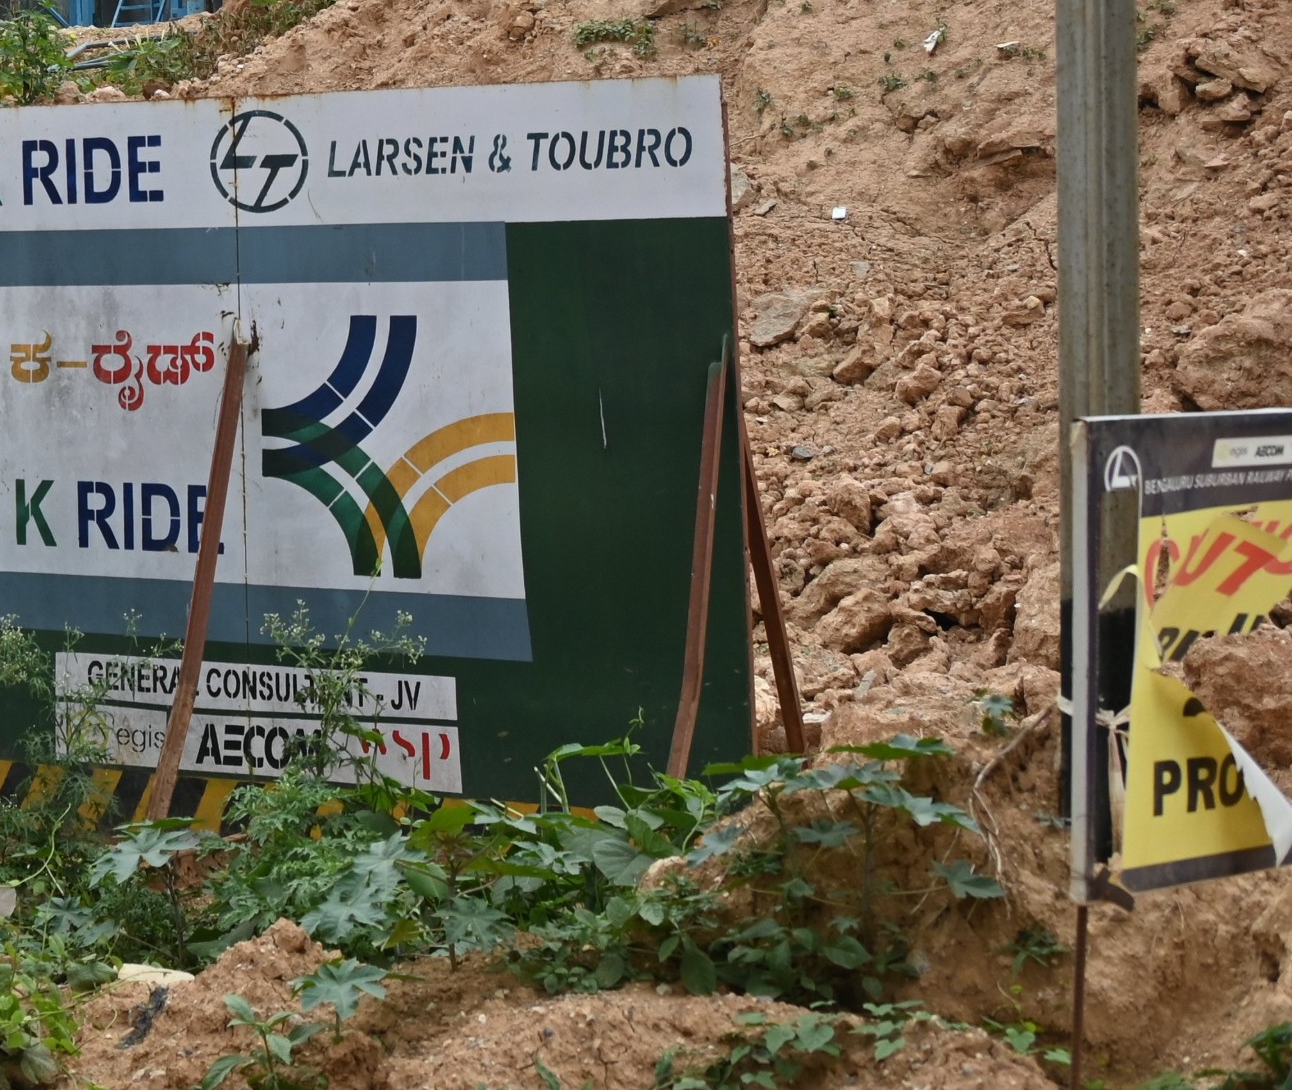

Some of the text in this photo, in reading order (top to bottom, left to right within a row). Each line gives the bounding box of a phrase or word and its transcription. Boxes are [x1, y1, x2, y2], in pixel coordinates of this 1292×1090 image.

[22, 135, 164, 206] RIDE
[327, 127, 693, 178] LARSEN & TOUBRO
[15, 478, 57, 547] K
[87, 660, 199, 697] GENERA
[391, 679, 421, 710] JV
[116, 725, 166, 753] egis
